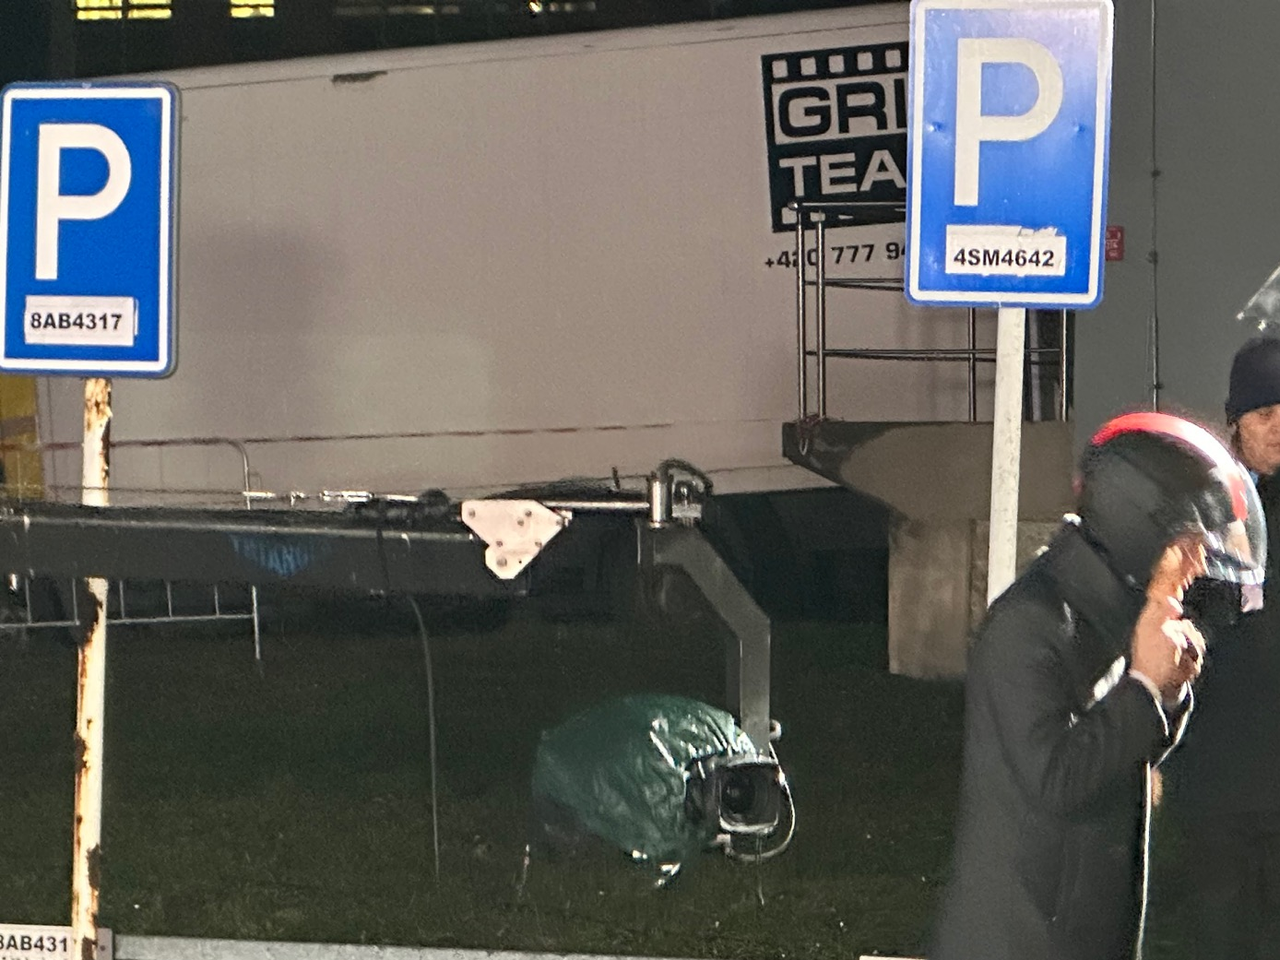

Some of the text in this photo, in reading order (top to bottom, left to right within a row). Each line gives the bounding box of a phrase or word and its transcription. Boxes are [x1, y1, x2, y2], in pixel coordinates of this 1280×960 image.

[778, 78, 907, 138] GRI
[954, 37, 1063, 207] P
[779, 149, 906, 198] TEA
[35, 123, 132, 280] P
[831, 244, 875, 264] 777
[953, 249, 1055, 267] 4SM4642
[30, 312, 122, 330] 8AB4317
